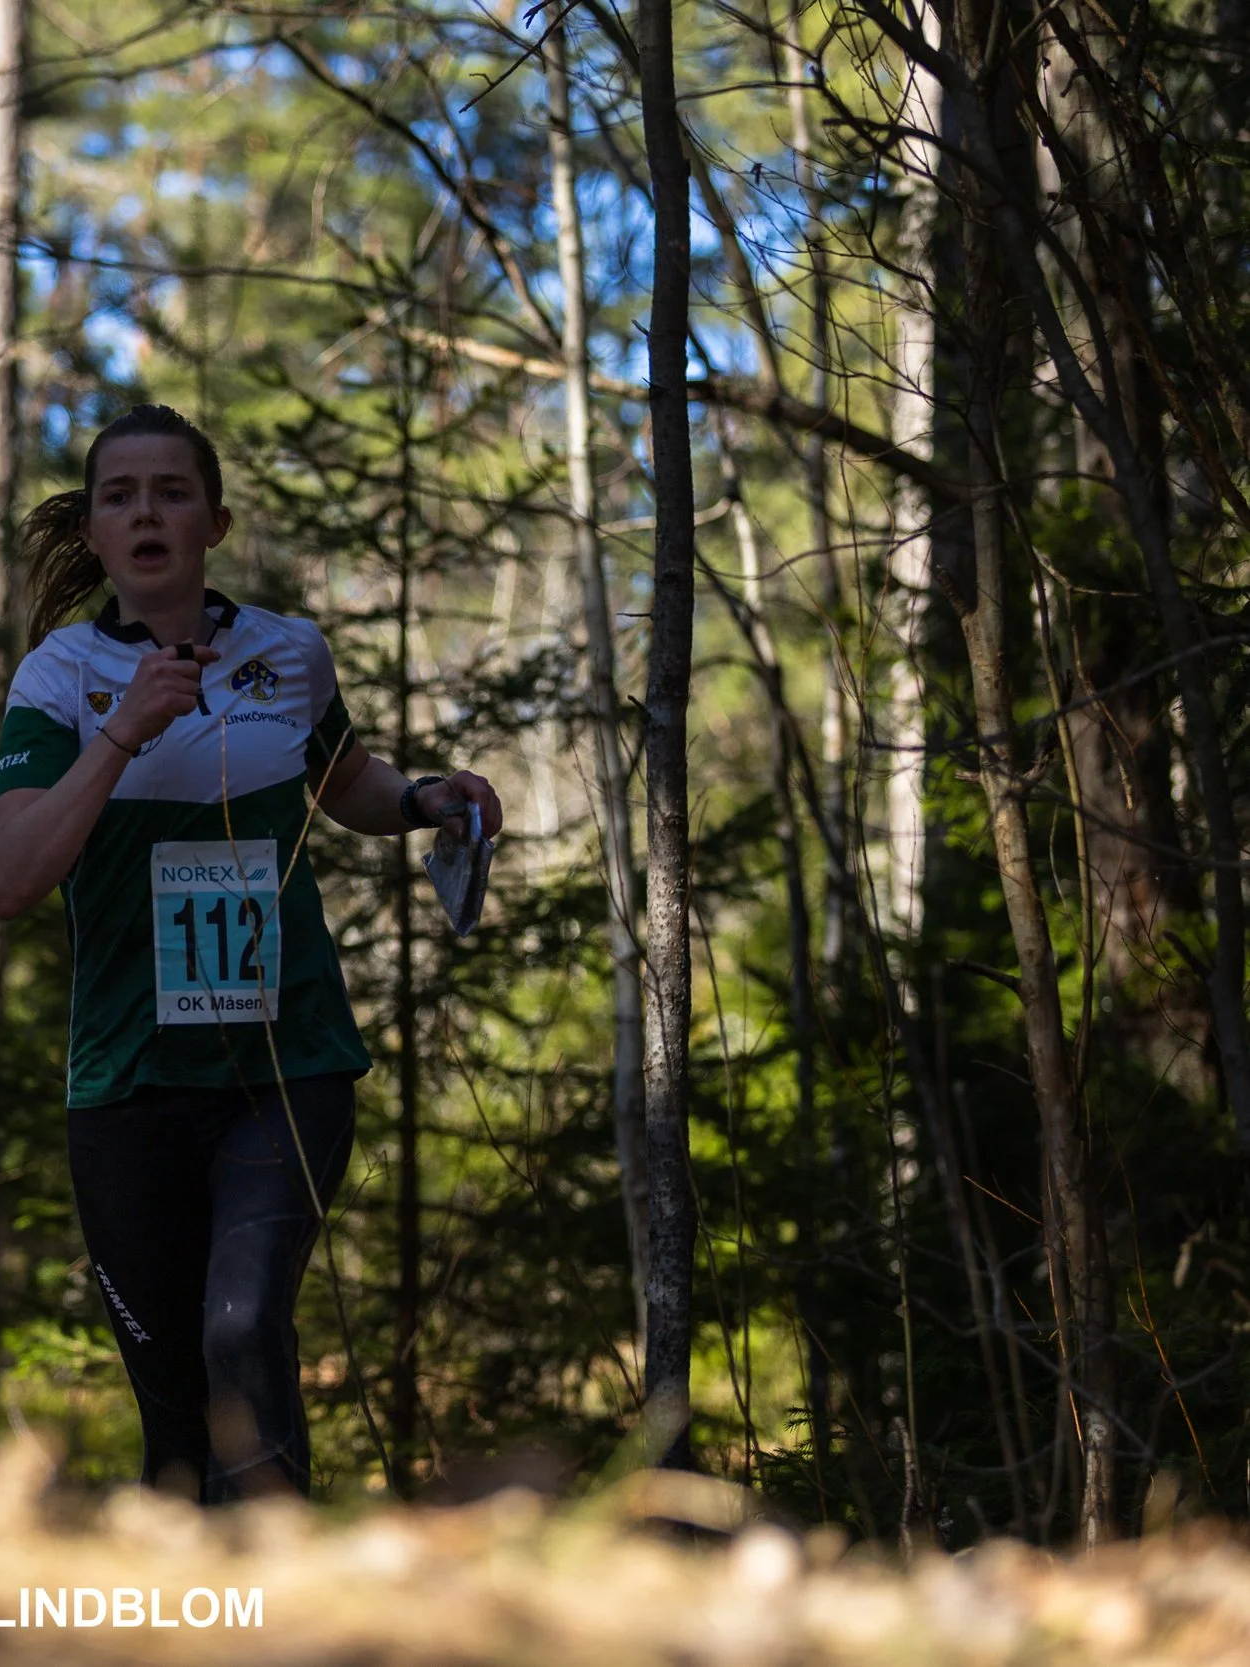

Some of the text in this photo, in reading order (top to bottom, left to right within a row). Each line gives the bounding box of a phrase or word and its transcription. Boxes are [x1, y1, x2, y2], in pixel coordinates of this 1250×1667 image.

[225, 711, 287, 725] LINKÖPINGS
[161, 865, 235, 882] NOREX
[173, 896, 266, 982] 112
[177, 994, 263, 1012] OK Måsen
[95, 1263, 152, 1343] TRIMTEX
